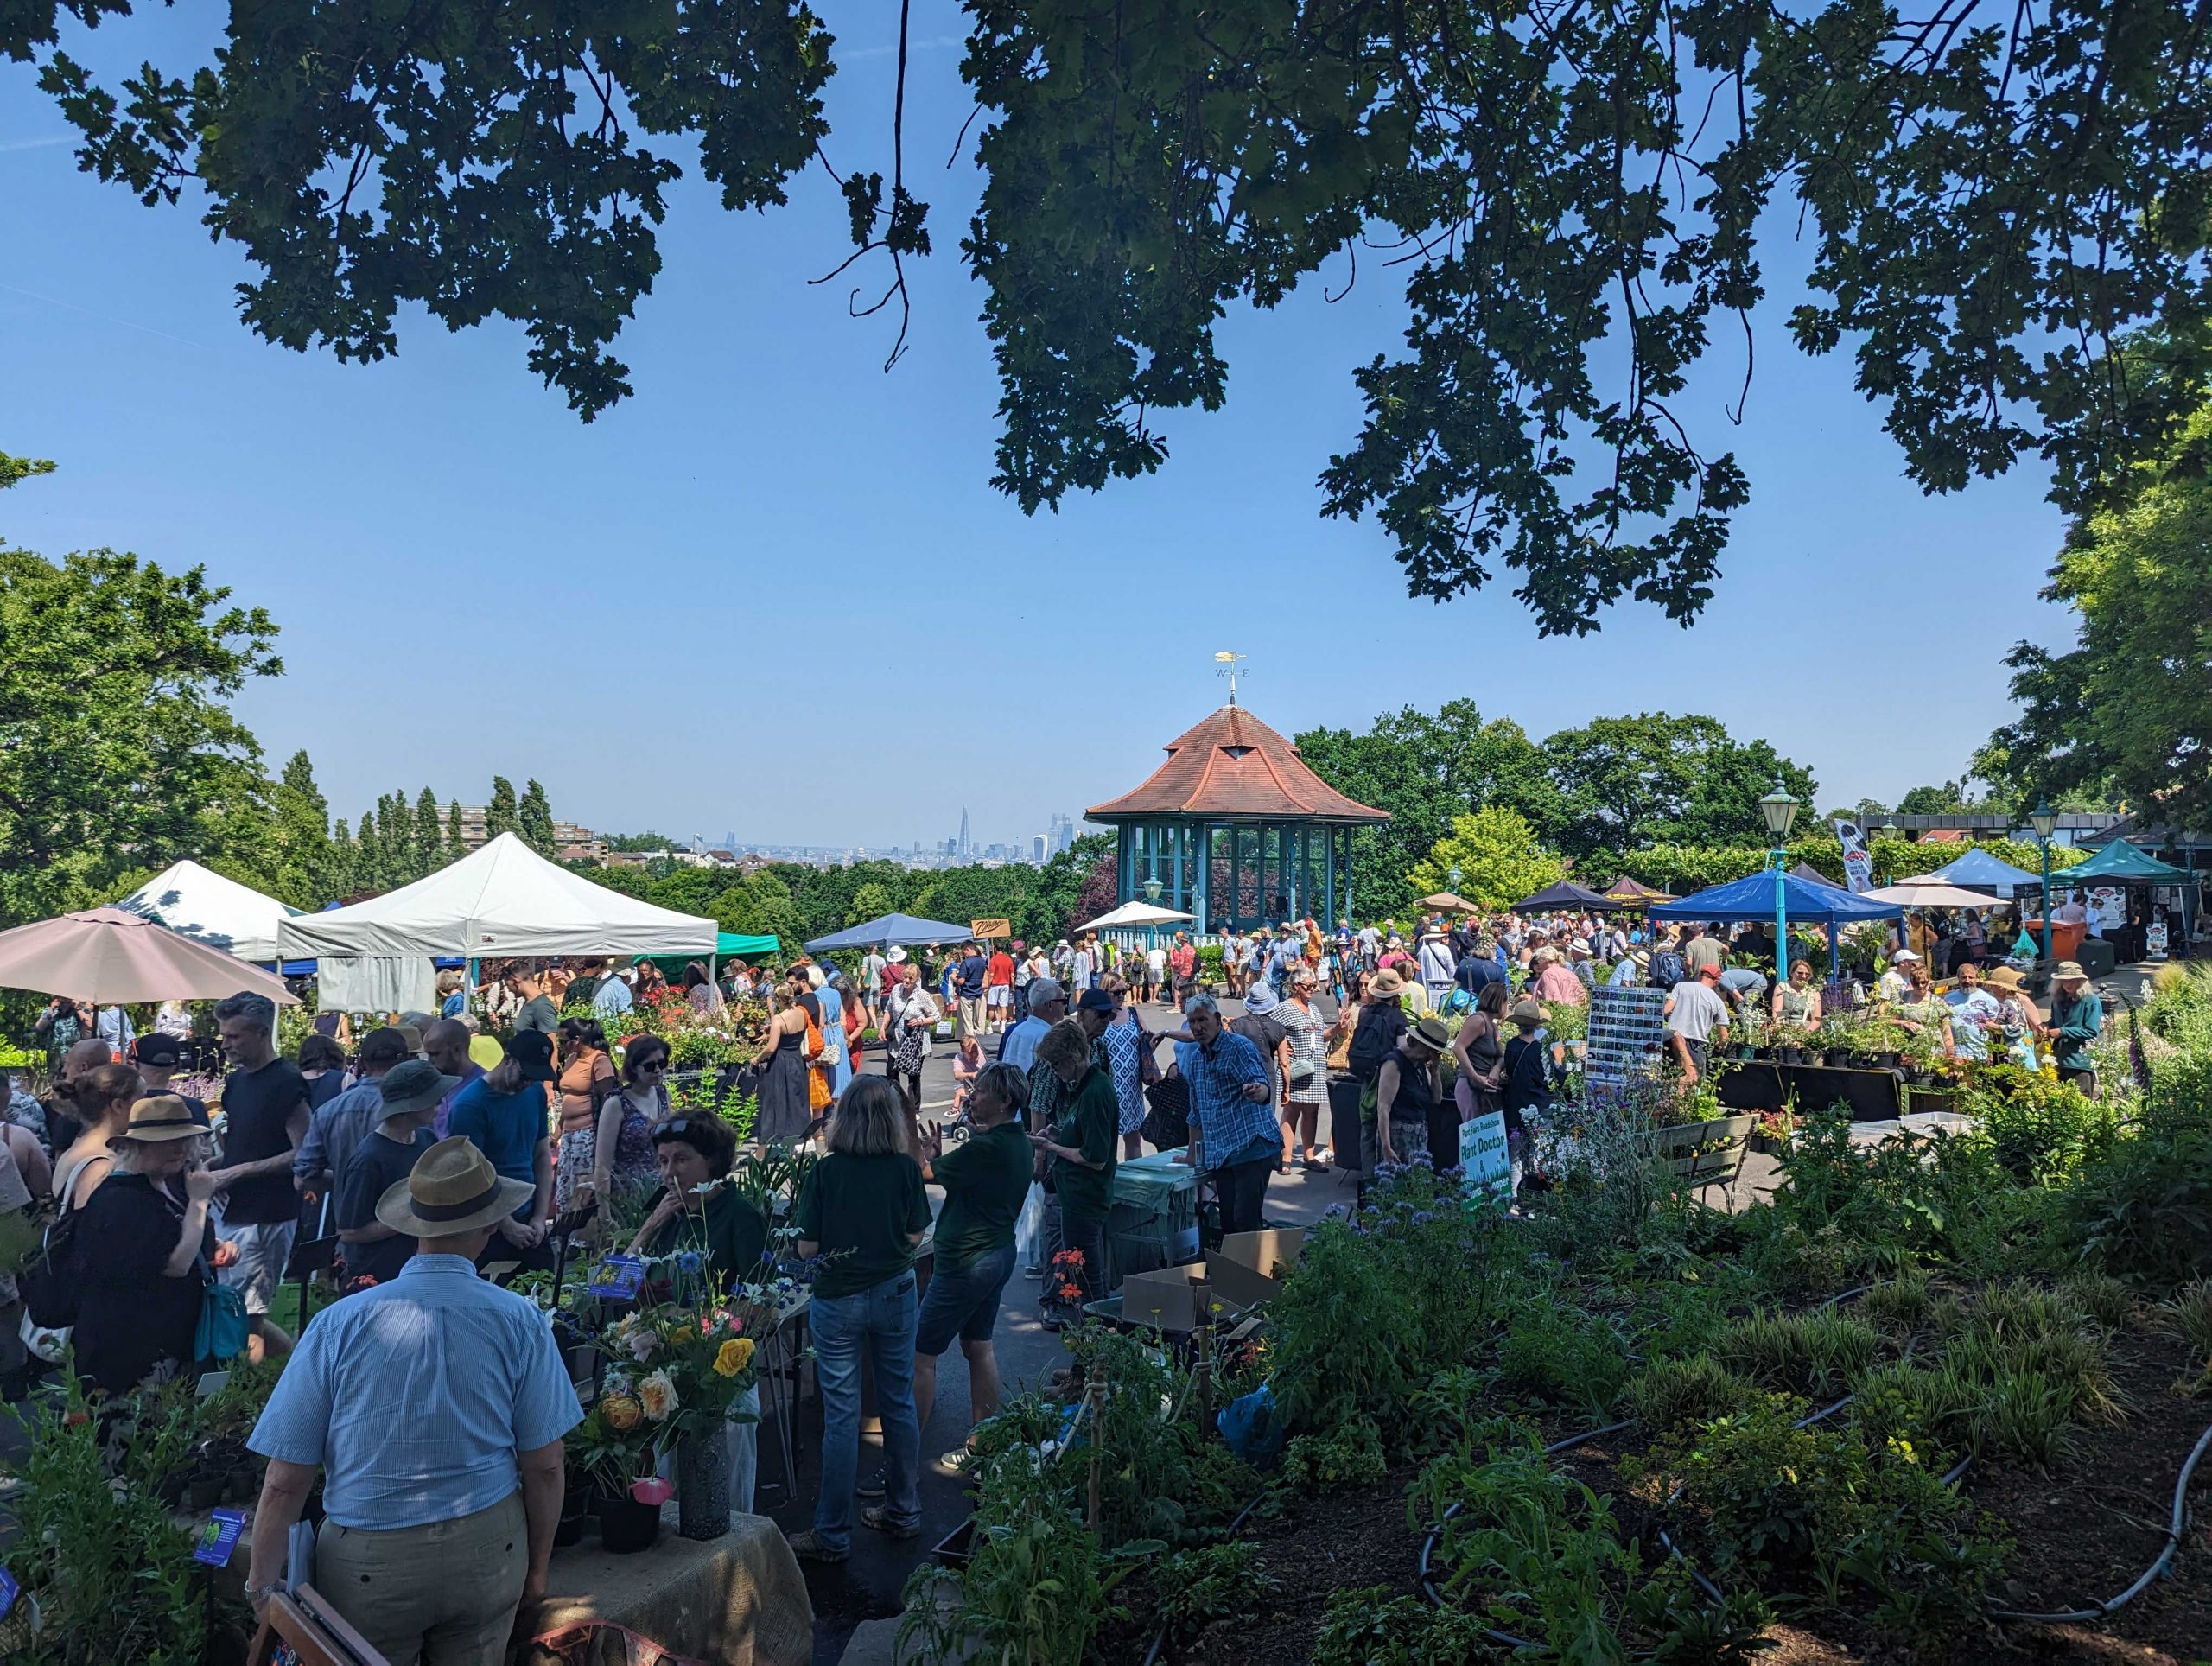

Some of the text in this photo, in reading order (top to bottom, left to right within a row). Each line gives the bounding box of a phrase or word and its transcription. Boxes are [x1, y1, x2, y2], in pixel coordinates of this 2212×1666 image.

[1215, 669, 1227, 677] W
[1243, 669, 1249, 678] E
[1479, 1119, 1500, 1130] Roadshow
[1461, 1135, 1505, 1162] Plant Doctor
[1479, 1160, 1484, 1173] &
